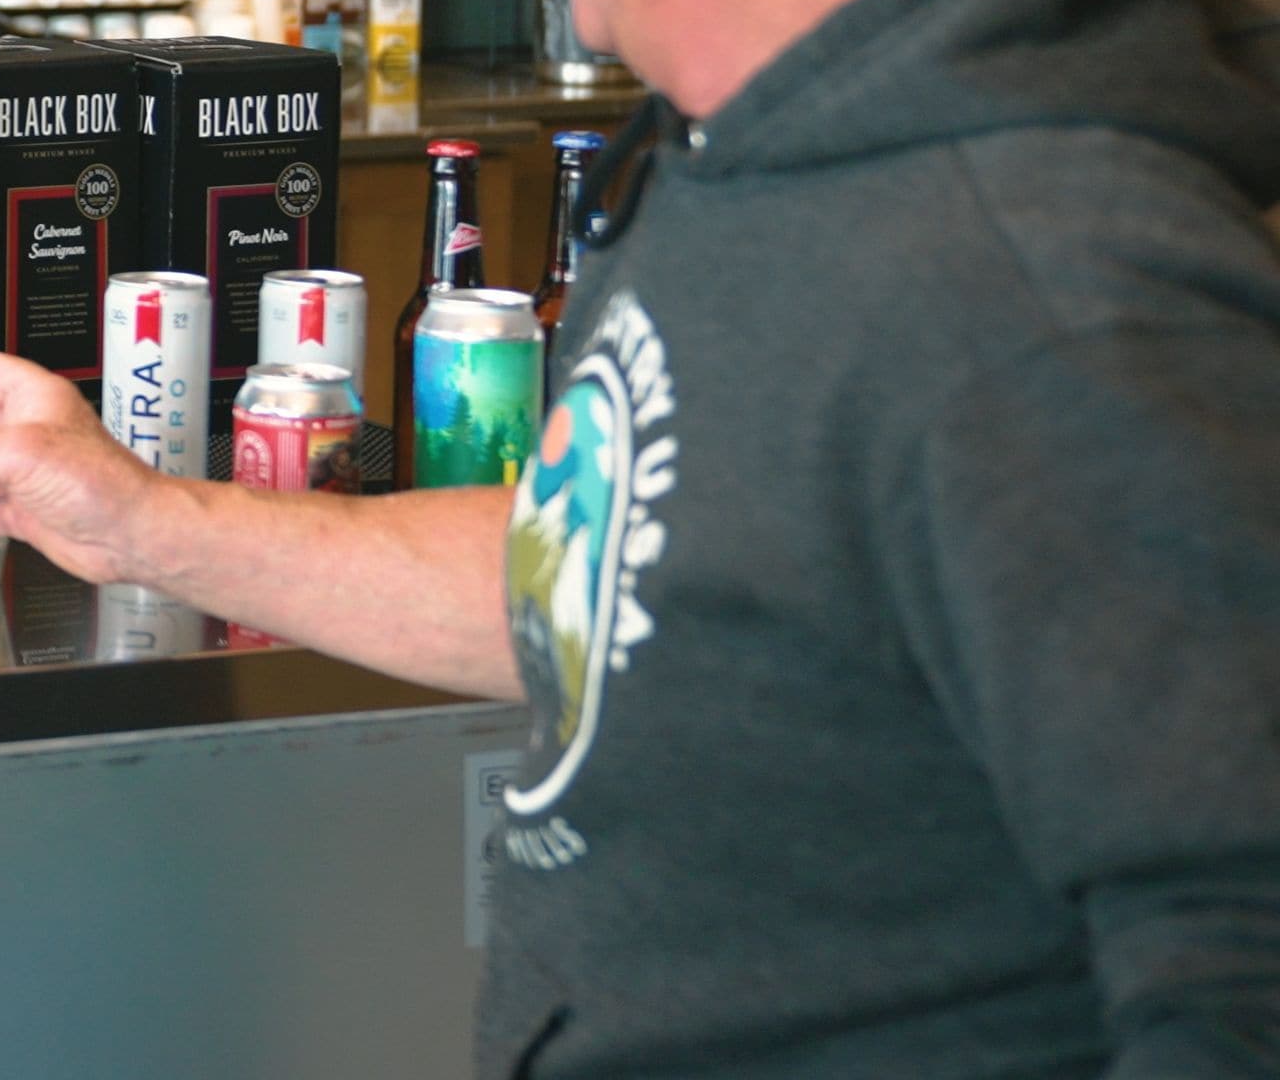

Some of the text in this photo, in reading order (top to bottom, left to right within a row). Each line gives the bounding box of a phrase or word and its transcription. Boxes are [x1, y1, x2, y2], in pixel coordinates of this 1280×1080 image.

[76, 92, 118, 135] BOX
[198, 92, 319, 138] BLACK BOX
[86, 180, 109, 195] 100
[286, 178, 311, 194] 100
[33, 223, 82, 241] Cabernet
[228, 227, 289, 247] Pinot Noir
[28, 242, 87, 260] Sauvignon
